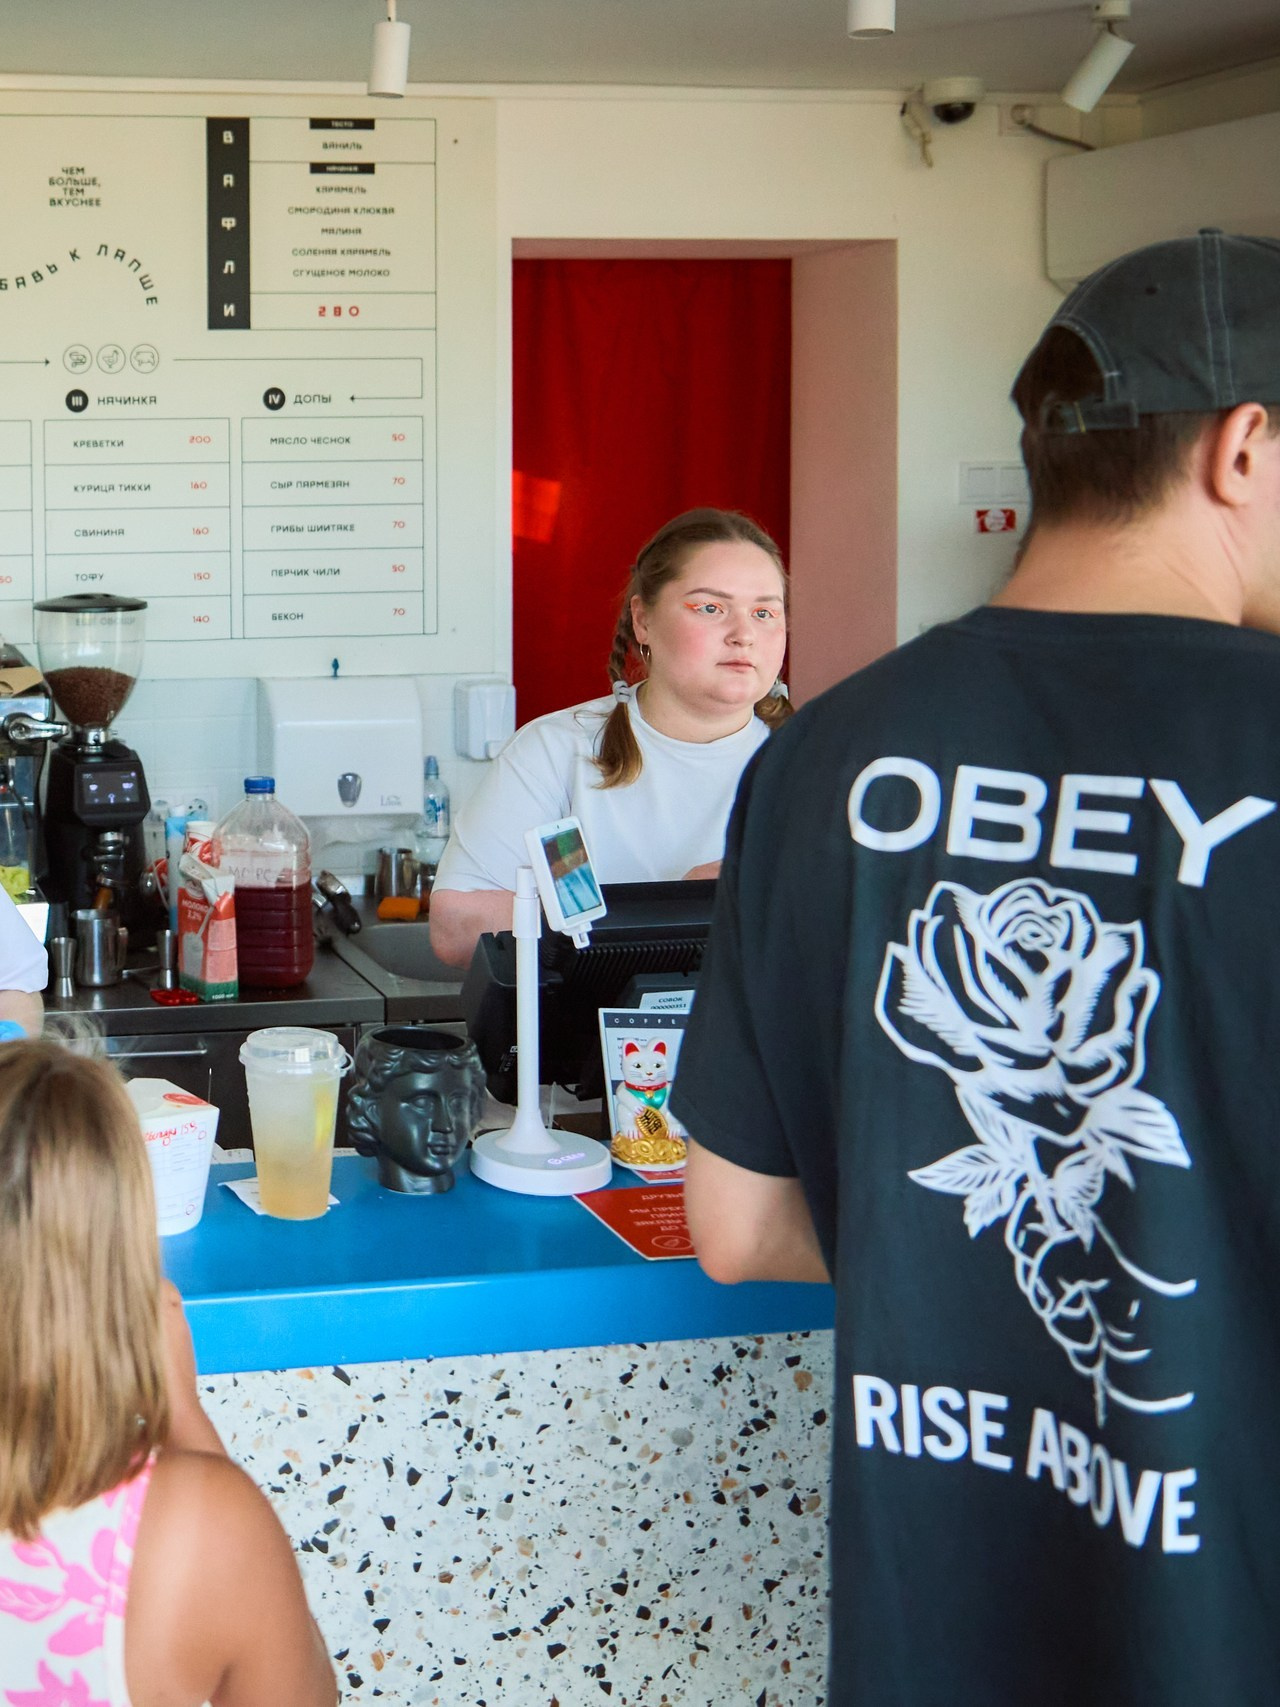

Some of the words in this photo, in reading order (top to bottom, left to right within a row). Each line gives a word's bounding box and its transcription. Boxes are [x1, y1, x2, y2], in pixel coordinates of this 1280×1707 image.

[322, 142, 362, 150] ВАНИЛЬ
[61, 167, 85, 175] ЧЕМ
[63, 188, 85, 196] ТЕМ
[316, 186, 366, 194] КАРАМЕЛЬ
[49, 198, 101, 207] ВКУСНЕЕ
[288, 206, 350, 216] СМОРОДИНА
[353, 206, 395, 215] КЛЮКВА
[221, 130, 236, 317] ВАФЛИ
[321, 227, 362, 235] МАЛИНА
[69, 249, 80, 262] К
[97, 244, 158, 305] ЛАПШЕ
[349, 269, 390, 277] МОЛОКО
[98, 395, 157, 406] НАЧИНКА
[293, 394, 332, 405] ДОПЫ
[73, 440, 124, 448] КРЕВЕТКИ
[270, 437, 307, 445] МАСЛО
[310, 436, 351, 444] ЧЕСНОК
[73, 484, 115, 493] КУРИЦА
[119, 483, 151, 492] ТИККИ
[270, 481, 293, 489] СЫР
[296, 480, 350, 488] ПАРМЕЗАН
[74, 528, 125, 537] СВИНИНА
[271, 524, 304, 533] ГРИБЫ
[307, 524, 355, 532] ШИИТАКЕ
[271, 568, 309, 577] ПЕРЧИК
[313, 568, 340, 576] ЧИЛИ
[75, 573, 104, 582] ТОФУ
[271, 612, 304, 621] БЕКОН
[848, 756, 1276, 888] OBEY
[852, 1375, 1012, 1471] RISE
[1026, 1408, 1200, 1554] ABOVE
